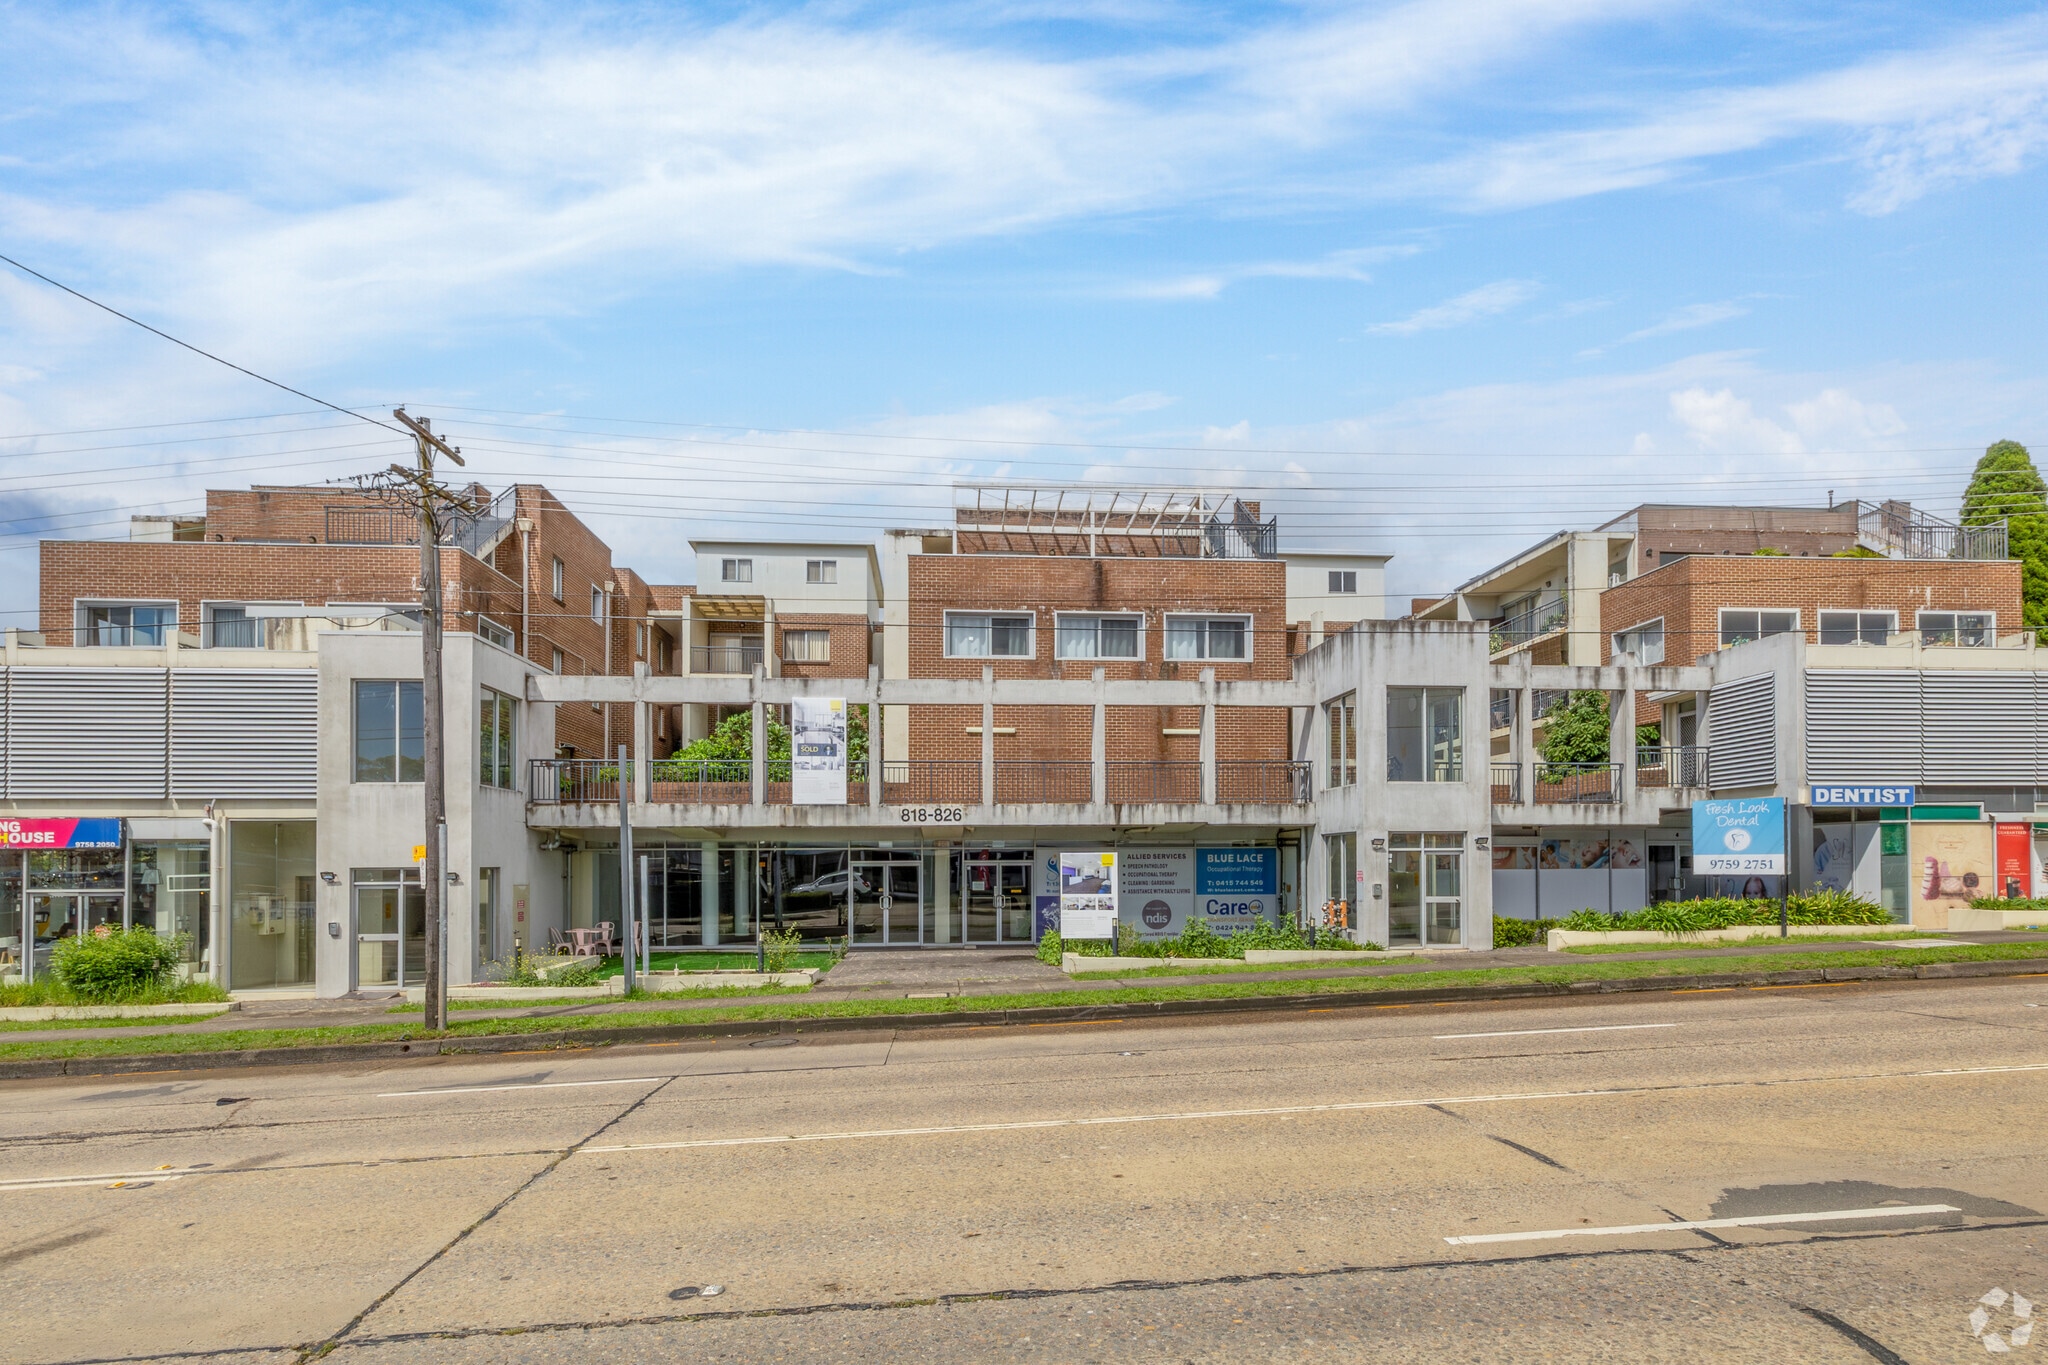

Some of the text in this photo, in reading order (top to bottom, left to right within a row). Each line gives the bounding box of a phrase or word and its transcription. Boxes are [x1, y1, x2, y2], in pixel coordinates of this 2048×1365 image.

[1815, 788, 1910, 803] DENTIST
[1705, 800, 1770, 815] Fresh Look
[901, 807, 962, 822] 818-826
[1715, 814, 1760, 827] Dental
[1207, 853, 1264, 863] BLUE LACE
[1710, 859, 1774, 870] 9759 2751
[1146, 912, 1168, 923] ndis
